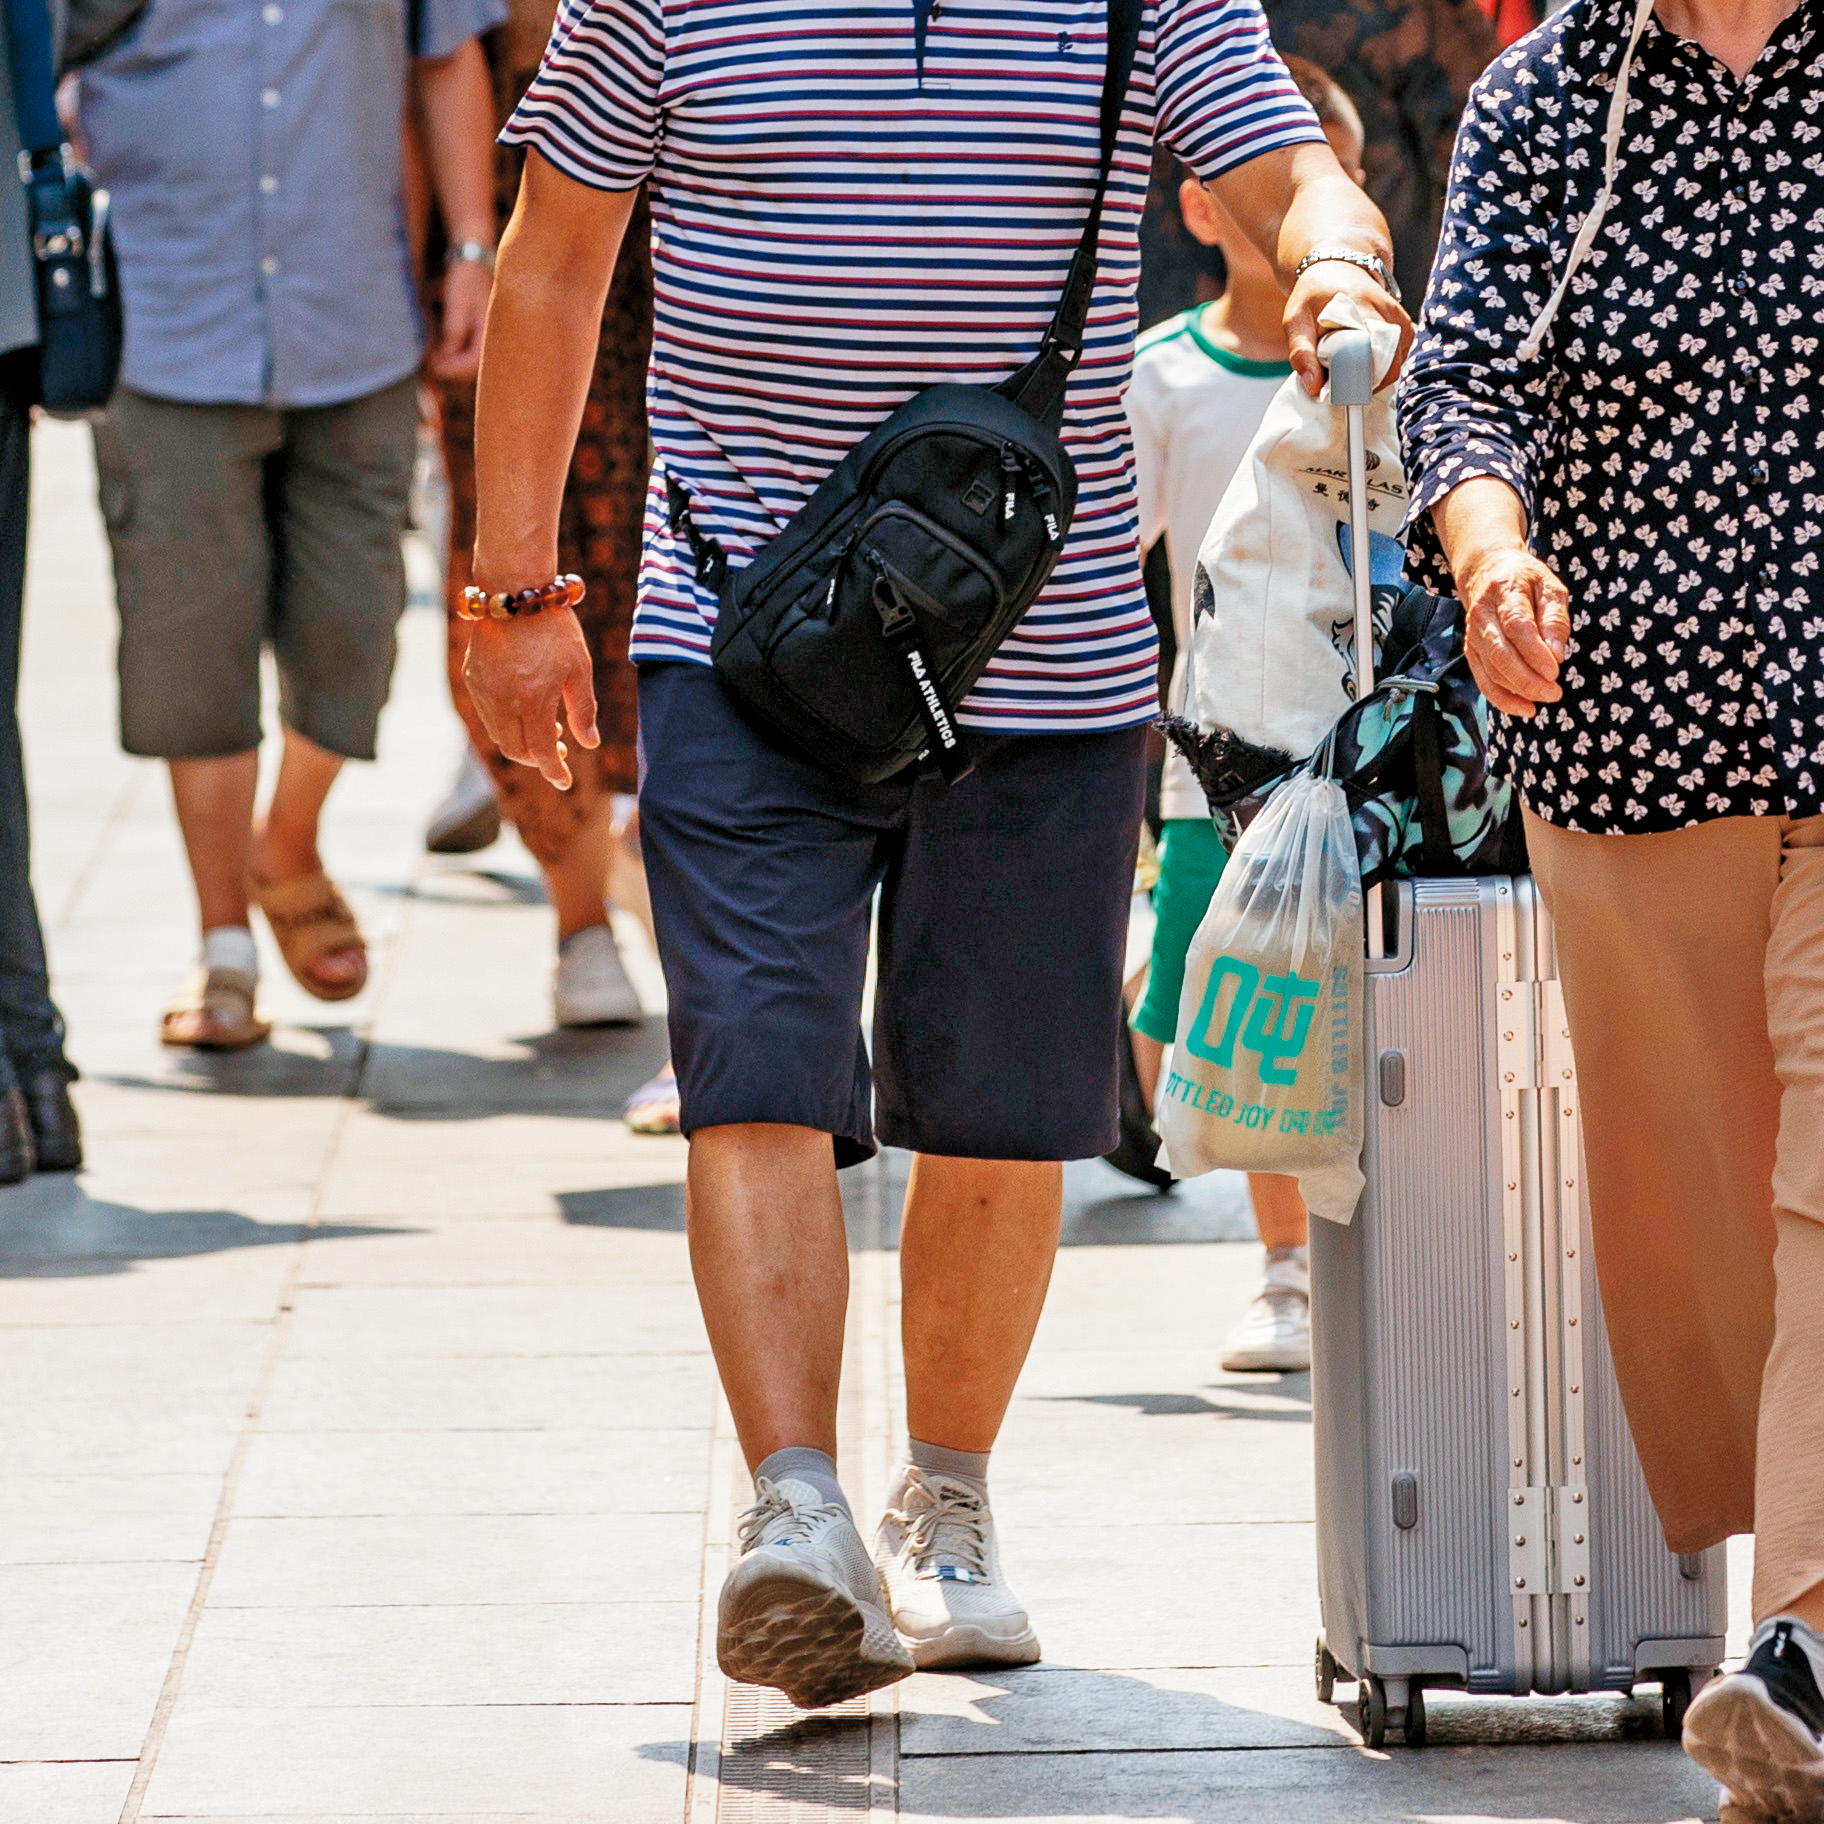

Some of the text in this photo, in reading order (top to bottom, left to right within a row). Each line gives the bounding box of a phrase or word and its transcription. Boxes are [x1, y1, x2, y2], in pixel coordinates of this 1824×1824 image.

[1005, 491, 1016, 520] FILA
[1043, 513, 1060, 542] FILA
[907, 649, 926, 680] FILA
[918, 679, 957, 749] ATHLETICS
[1234, 1103, 1275, 1132] JOY
